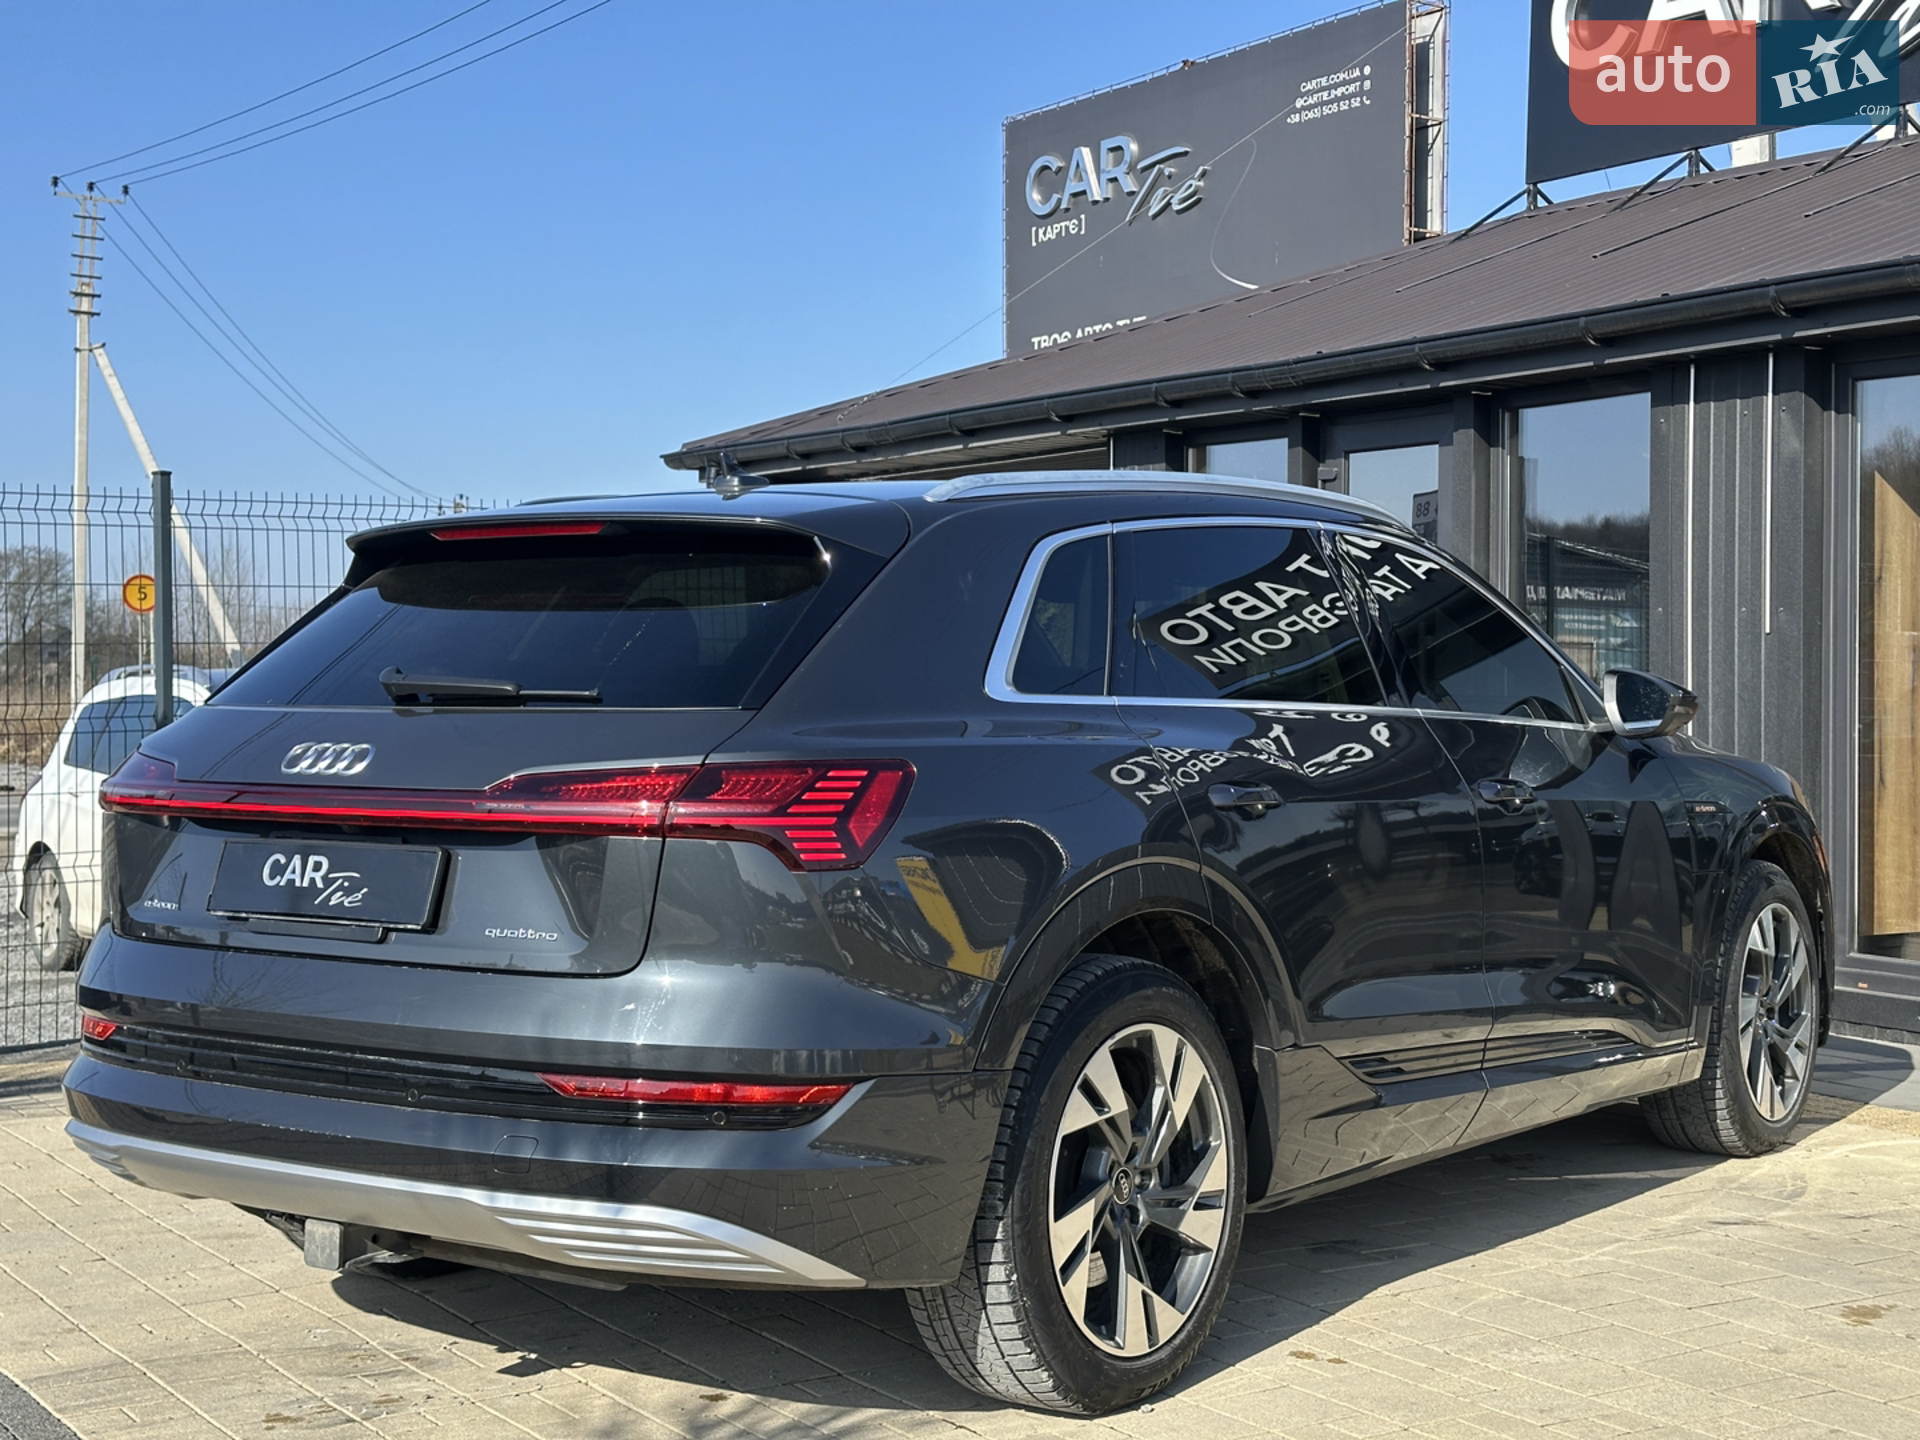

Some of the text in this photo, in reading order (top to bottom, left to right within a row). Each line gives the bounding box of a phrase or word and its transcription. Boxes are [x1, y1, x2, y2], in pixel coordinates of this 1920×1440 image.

[1300, 67, 1361, 92] CARTIE.COM.UA
[1286, 96, 1361, 124] +38 (063) 505 52 52
[1025, 135, 1139, 217] CAR
[137, 585, 148, 601] 5
[262, 852, 329, 889] CAR
[485, 927, 558, 941] quattro
